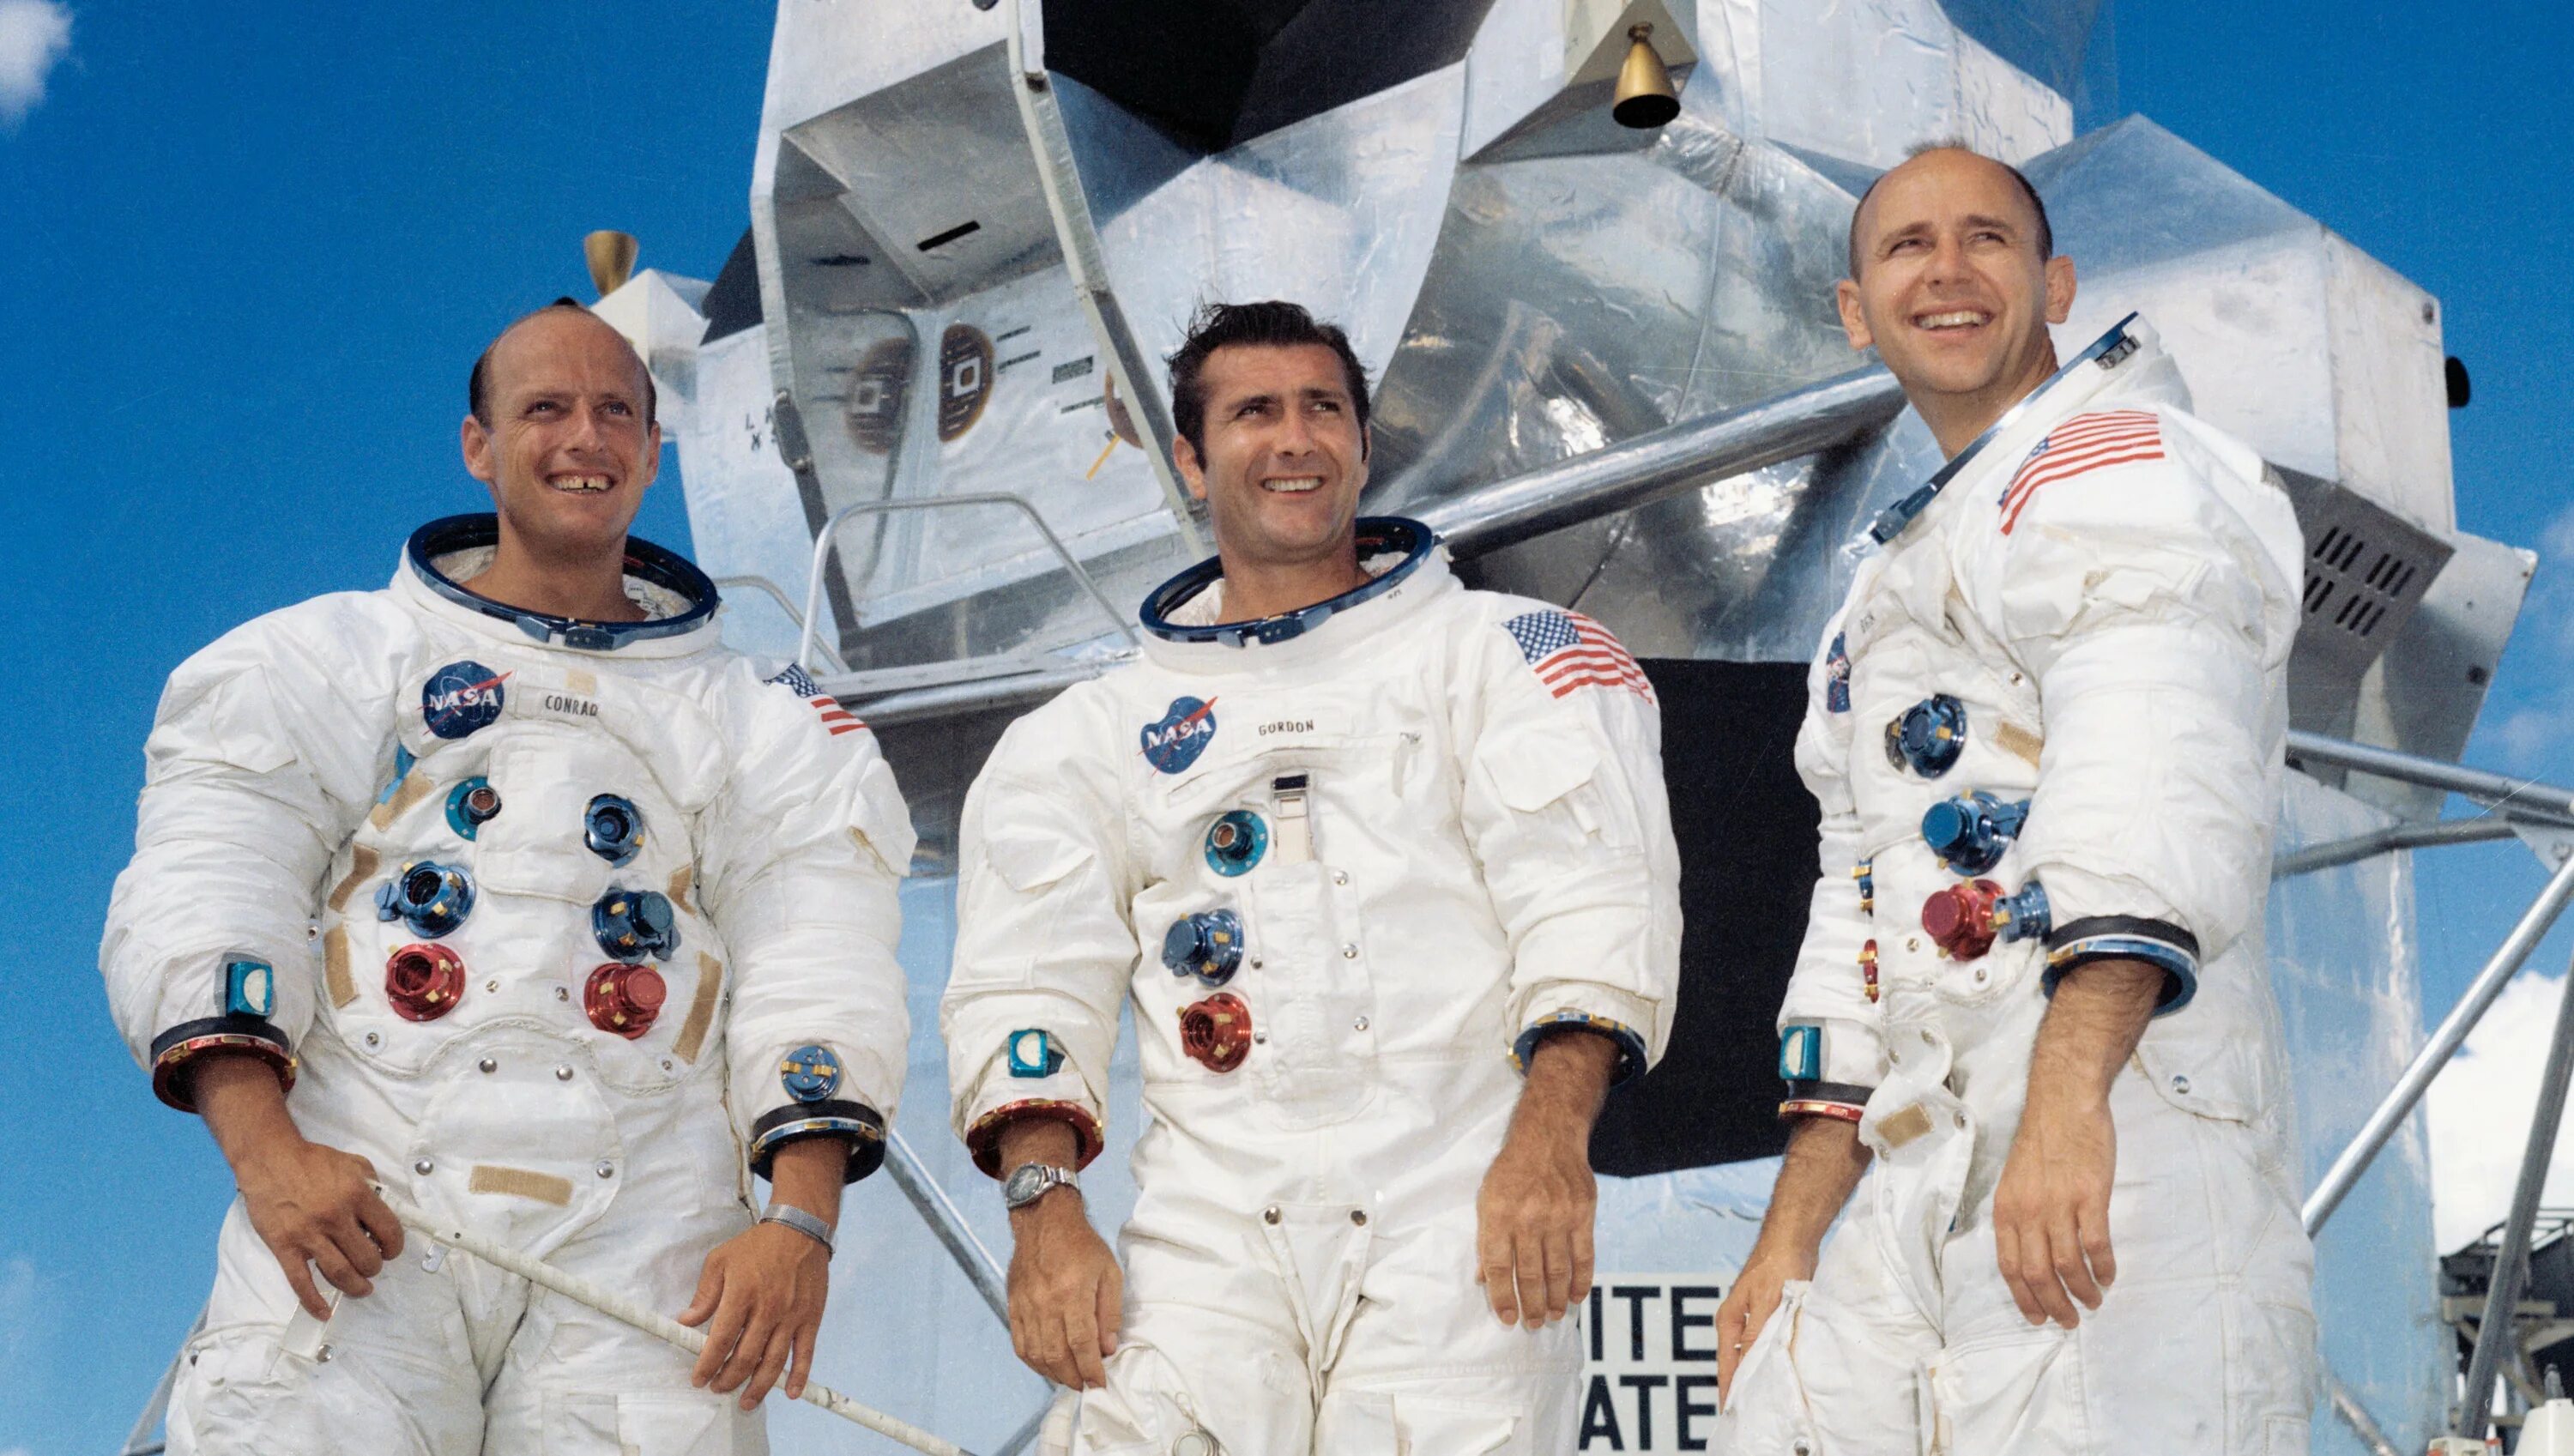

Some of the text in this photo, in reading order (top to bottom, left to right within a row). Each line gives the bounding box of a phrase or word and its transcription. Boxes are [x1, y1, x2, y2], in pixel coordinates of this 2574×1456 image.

[429, 688, 499, 711] NASA
[546, 695, 598, 716] CONRAD
[1146, 718, 1213, 749] NASA
[1258, 719, 1314, 736] GORDON
[1591, 1286, 1719, 1361] ITE
[1579, 1374, 1718, 1450] ATE
